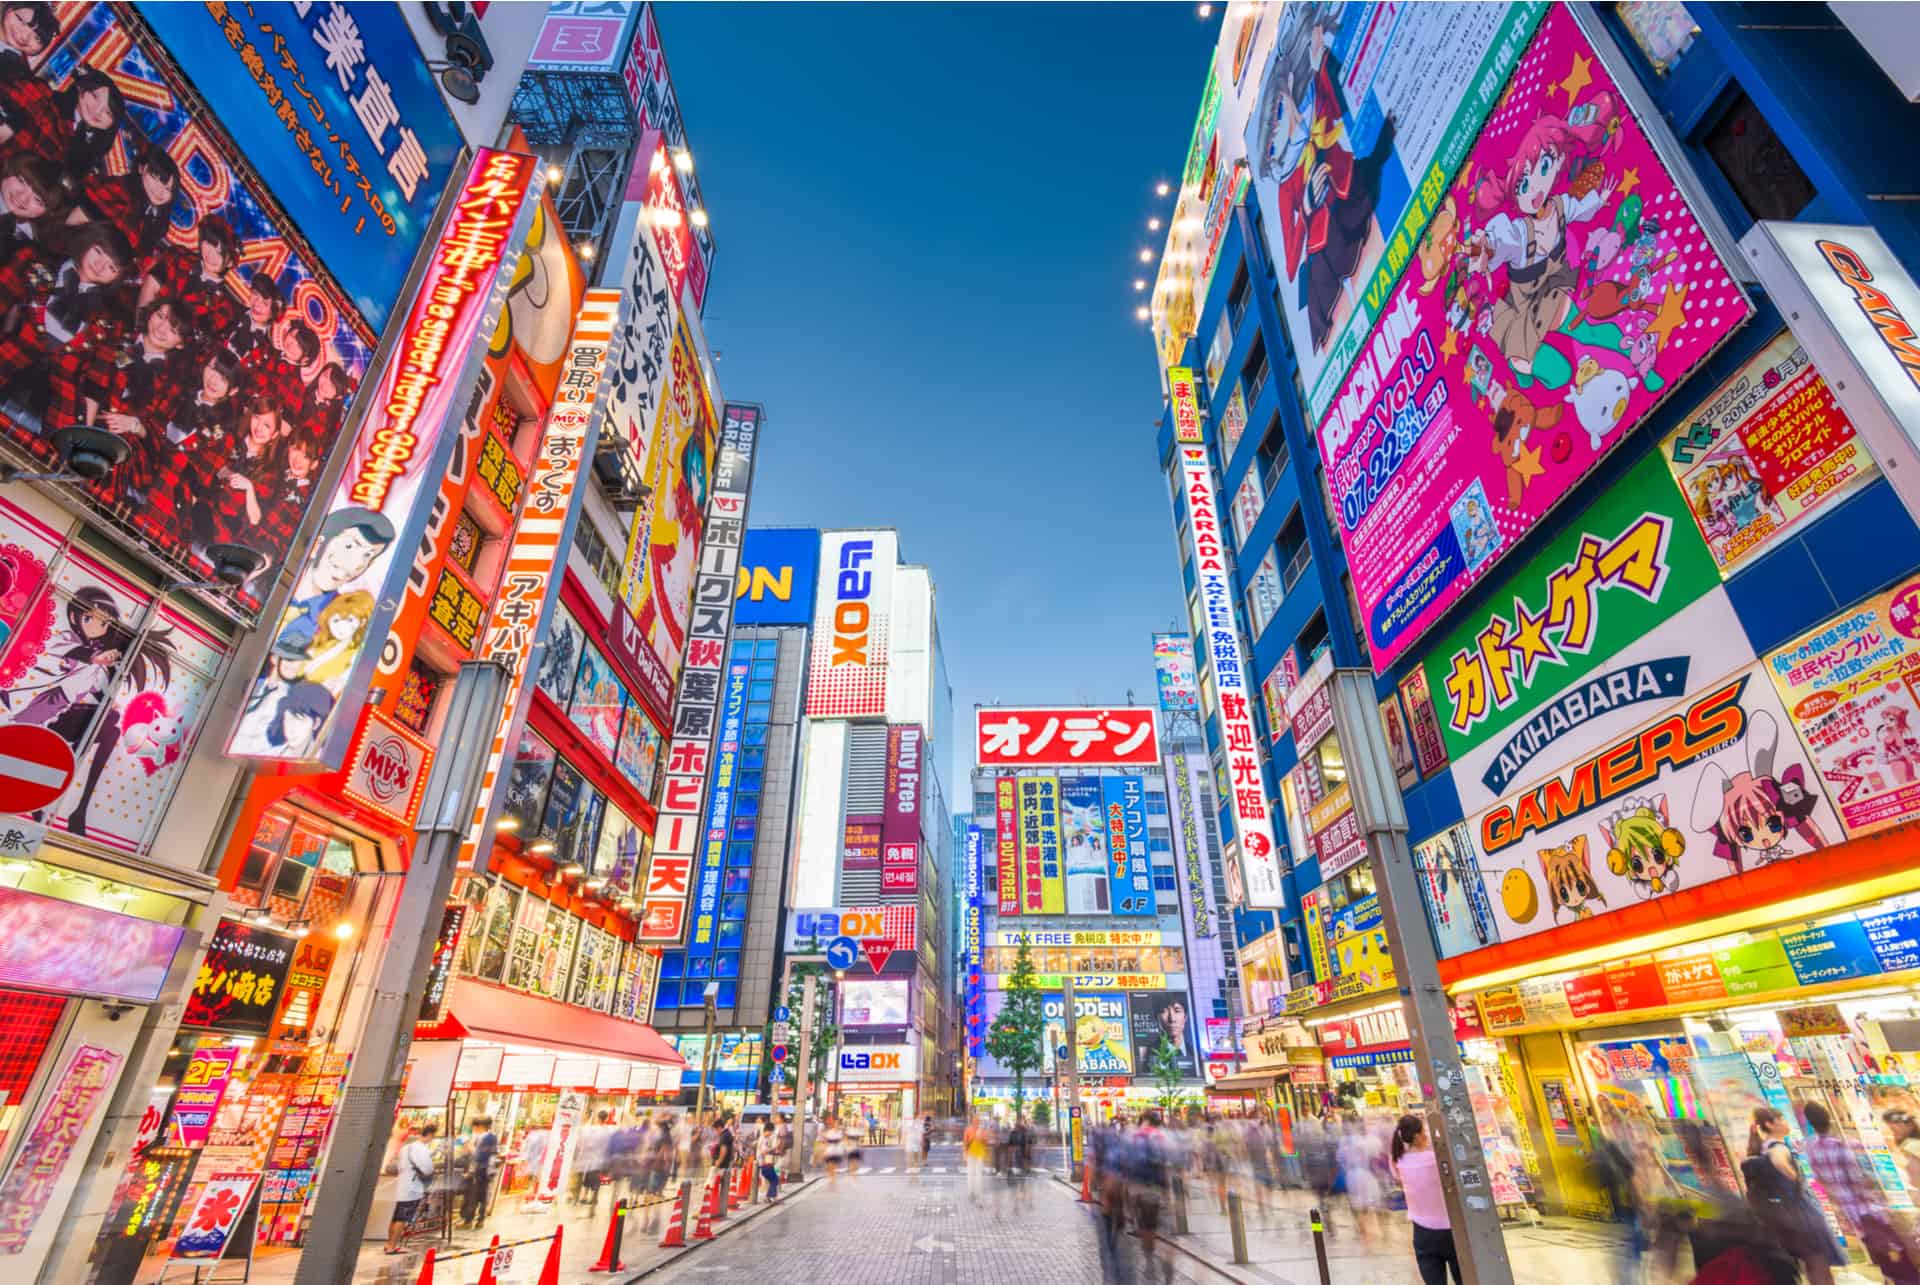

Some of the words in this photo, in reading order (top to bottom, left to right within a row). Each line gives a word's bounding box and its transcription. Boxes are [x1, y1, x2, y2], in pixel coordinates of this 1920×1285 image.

[292, 0, 429, 203] 業宣言
[1812, 238, 1920, 393] GAM
[565, 346, 603, 404] 買取り
[716, 408, 742, 489] PARADISE
[738, 408, 759, 463] HOBBY
[535, 435, 577, 513] まっくす
[1342, 430, 1403, 530] 07.22
[1187, 471, 1223, 570] TAKARADA
[1211, 631, 1242, 688] 免税商店
[641, 520, 741, 940] ボークス秋葉原ホビー天国
[897, 729, 920, 770] Duty
[981, 710, 1151, 758] オノデン
[1499, 665, 1662, 783] AKIHABARA
[1220, 692, 1266, 820] 歓迎光臨
[1481, 672, 1752, 857] GAMERS
[897, 773, 920, 814] Free
[1124, 780, 1143, 839] エアコン
[967, 831, 980, 898] Panasonic
[1121, 897, 1147, 912] 4F
[969, 906, 980, 965] ONODEN
[1005, 933, 1033, 945] TAX
[1035, 933, 1073, 945] FREE
[1074, 975, 1115, 987] エアコン
[184, 1060, 230, 1086] 2F
[191, 1187, 241, 1232] 氷
